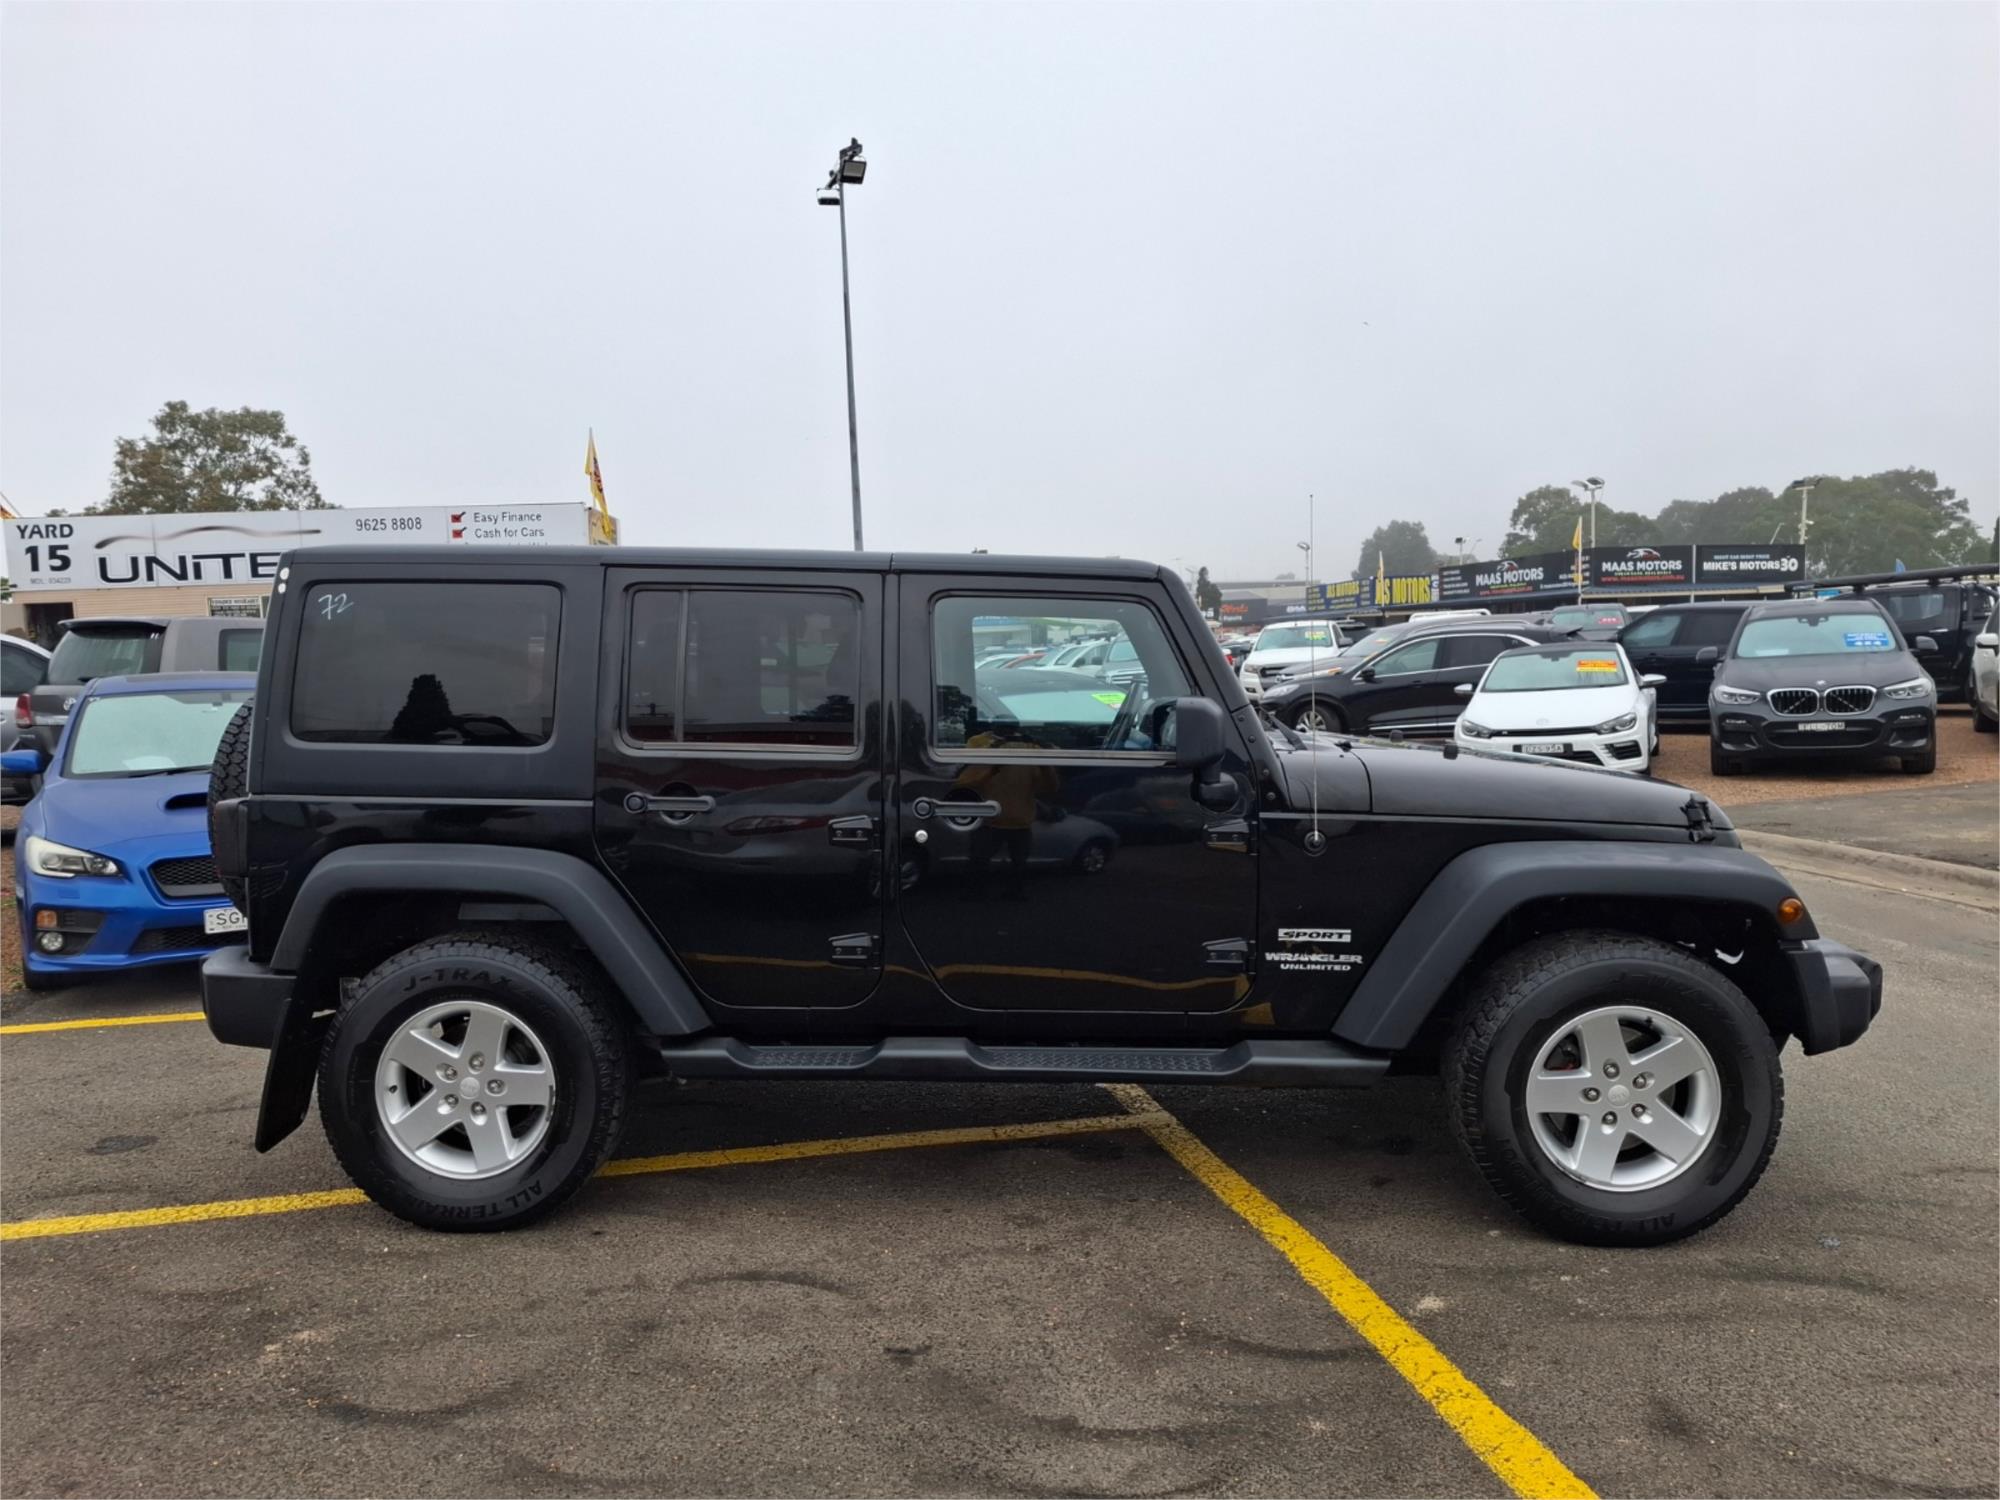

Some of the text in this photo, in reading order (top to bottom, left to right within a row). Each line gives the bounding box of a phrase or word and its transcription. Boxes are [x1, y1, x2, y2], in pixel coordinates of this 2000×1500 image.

[354, 516, 422, 532] 9625 8808
[473, 511, 542, 525] Easy Finance
[16, 523, 74, 540] YARD
[474, 526, 545, 539] Cash for Cars
[25, 543, 72, 572] 15
[1703, 557, 1799, 572] MIKE'S MOTORS 30
[1602, 560, 1634, 572] MAAS
[1636, 559, 1683, 572] MOTORS
[1475, 571, 1502, 586] MAAS
[1503, 567, 1544, 584] MOTORS
[1392, 576, 1431, 605] MOTORS
[1282, 930, 1347, 940] SPORT
[1264, 951, 1364, 964] WRANGLER
[1280, 963, 1352, 971] UNLIMITED
